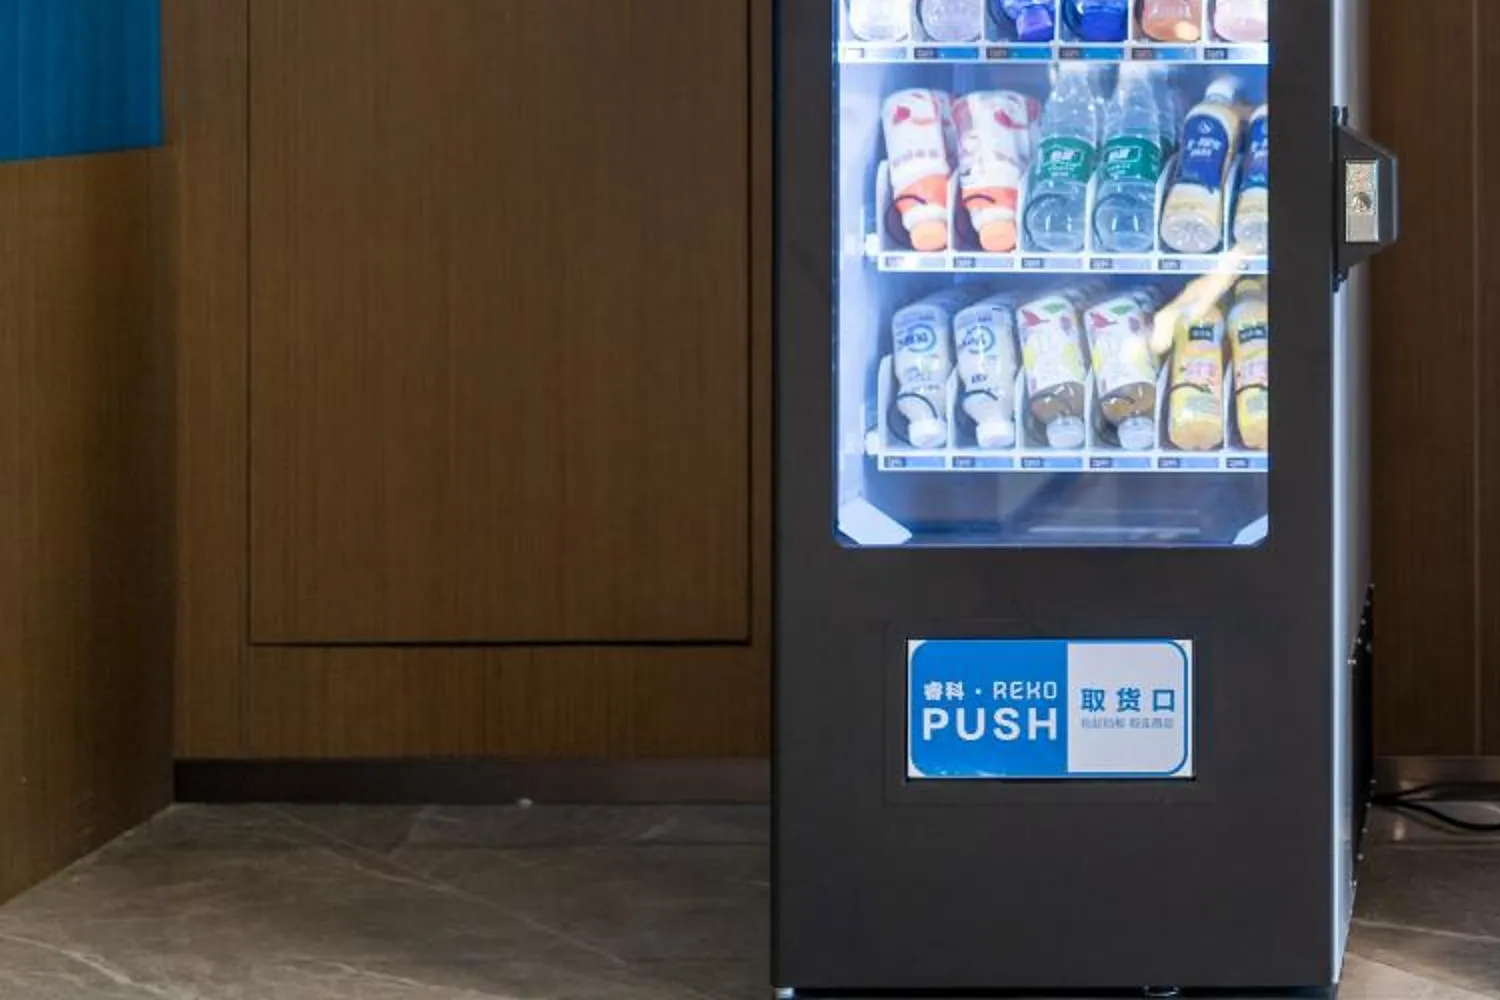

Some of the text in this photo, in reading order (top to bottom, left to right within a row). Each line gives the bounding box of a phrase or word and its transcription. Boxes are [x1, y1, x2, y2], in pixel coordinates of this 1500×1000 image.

[993, 681, 1058, 700] REKO
[1080, 687, 1176, 712] 取货口
[923, 707, 1058, 741] PUSH
